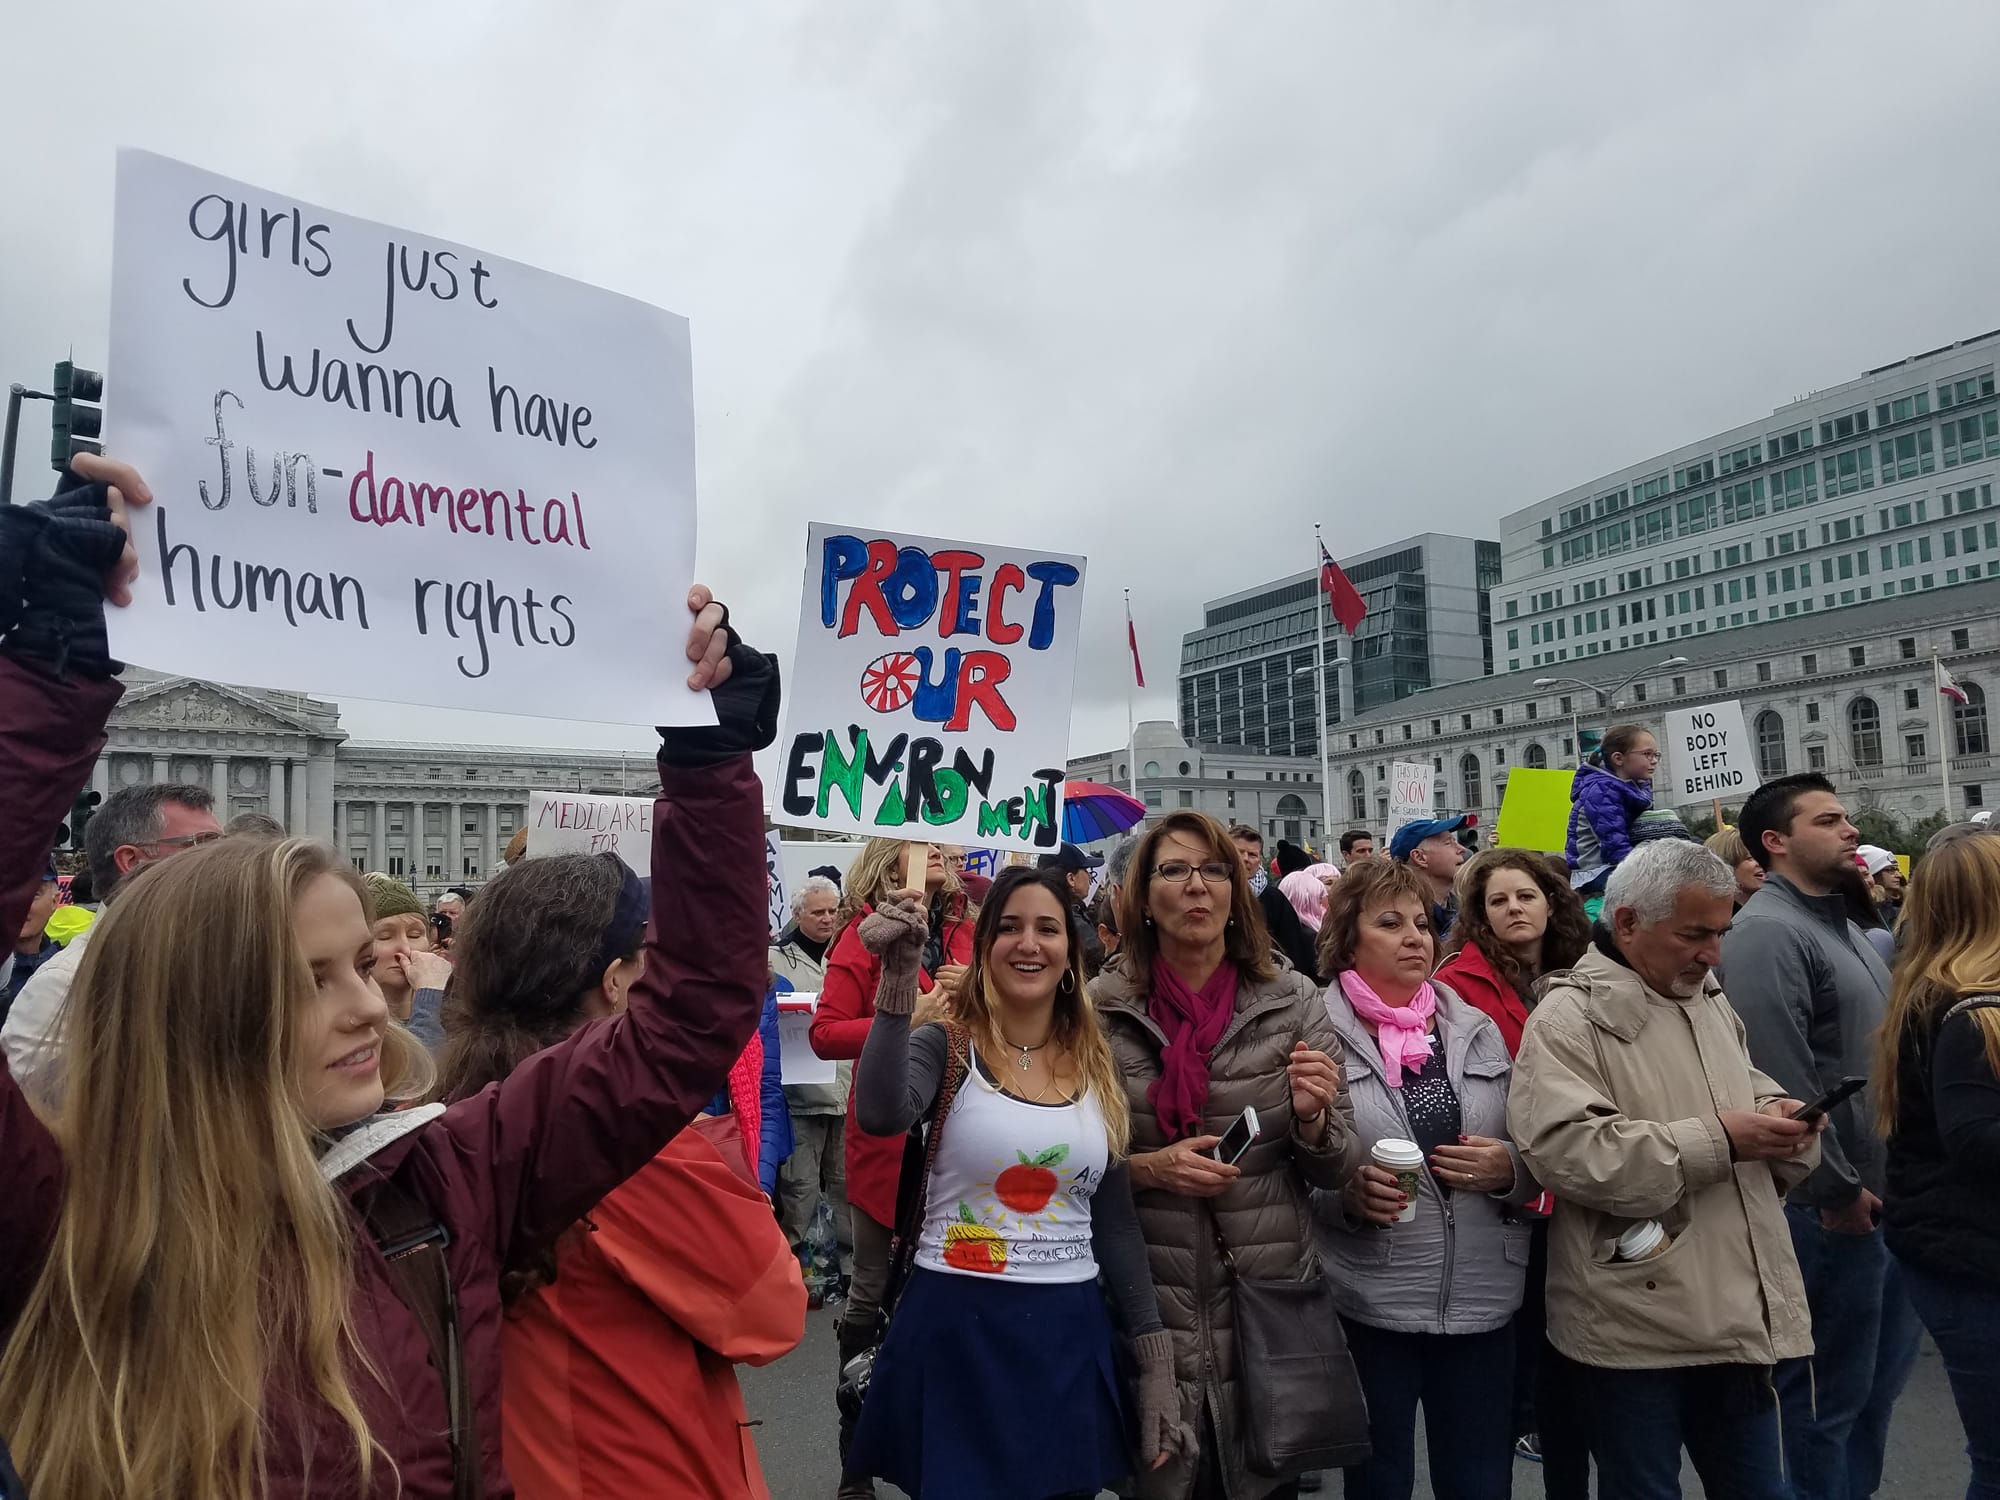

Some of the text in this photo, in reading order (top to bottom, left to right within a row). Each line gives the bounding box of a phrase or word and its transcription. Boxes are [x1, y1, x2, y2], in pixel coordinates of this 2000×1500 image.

[183, 194, 498, 353] girls just
[256, 330, 598, 449] wanna have
[198, 389, 591, 550] fun-damental
[157, 506, 576, 677] human rights
[821, 535, 1080, 650] PROTECT
[860, 646, 1017, 732] OUR
[1691, 712, 1716, 730] NO
[1686, 731, 1727, 752] BODY
[1693, 751, 1728, 772] LEFT
[1394, 780, 1426, 805] SIGN
[1685, 770, 1743, 794] BEHIND
[537, 800, 652, 833] MEDICARE
[590, 834, 620, 854] FOR
